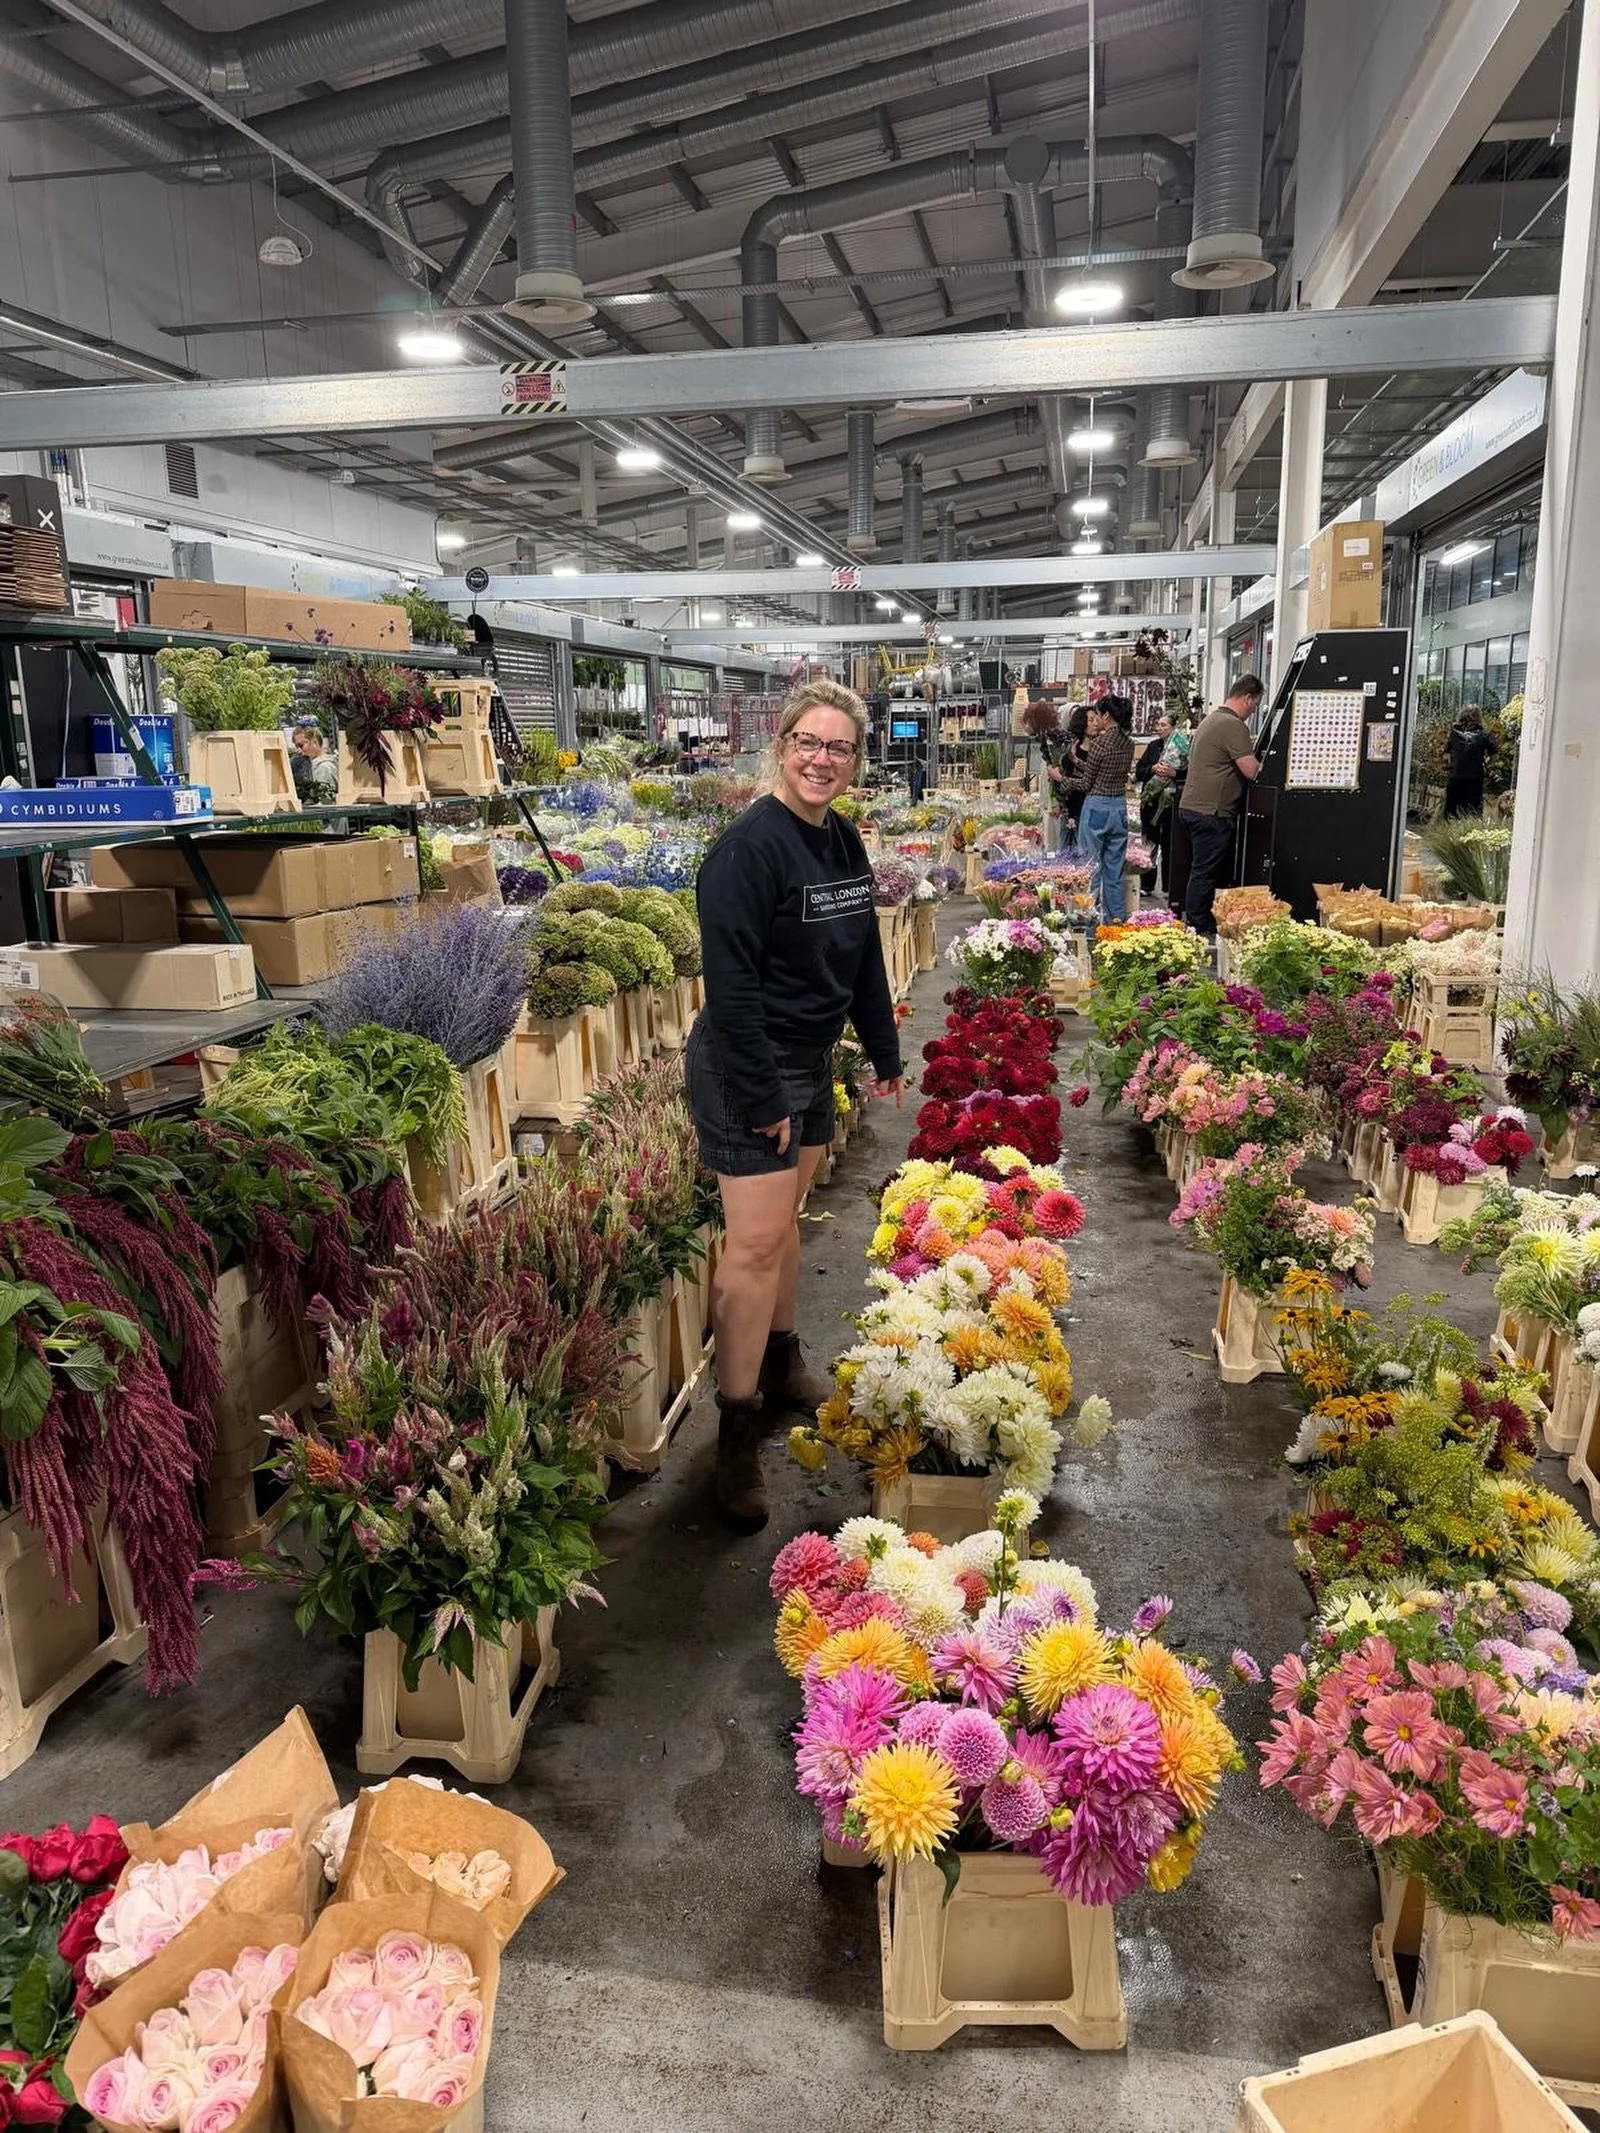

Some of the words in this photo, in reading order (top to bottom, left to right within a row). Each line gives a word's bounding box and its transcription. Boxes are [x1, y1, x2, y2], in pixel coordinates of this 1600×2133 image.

[517, 376, 550, 385] WARNING
[532, 385, 551, 393] LOAD
[11, 803, 122, 816] CYMBIDIUMS
[834, 883, 870, 901] LONDON
